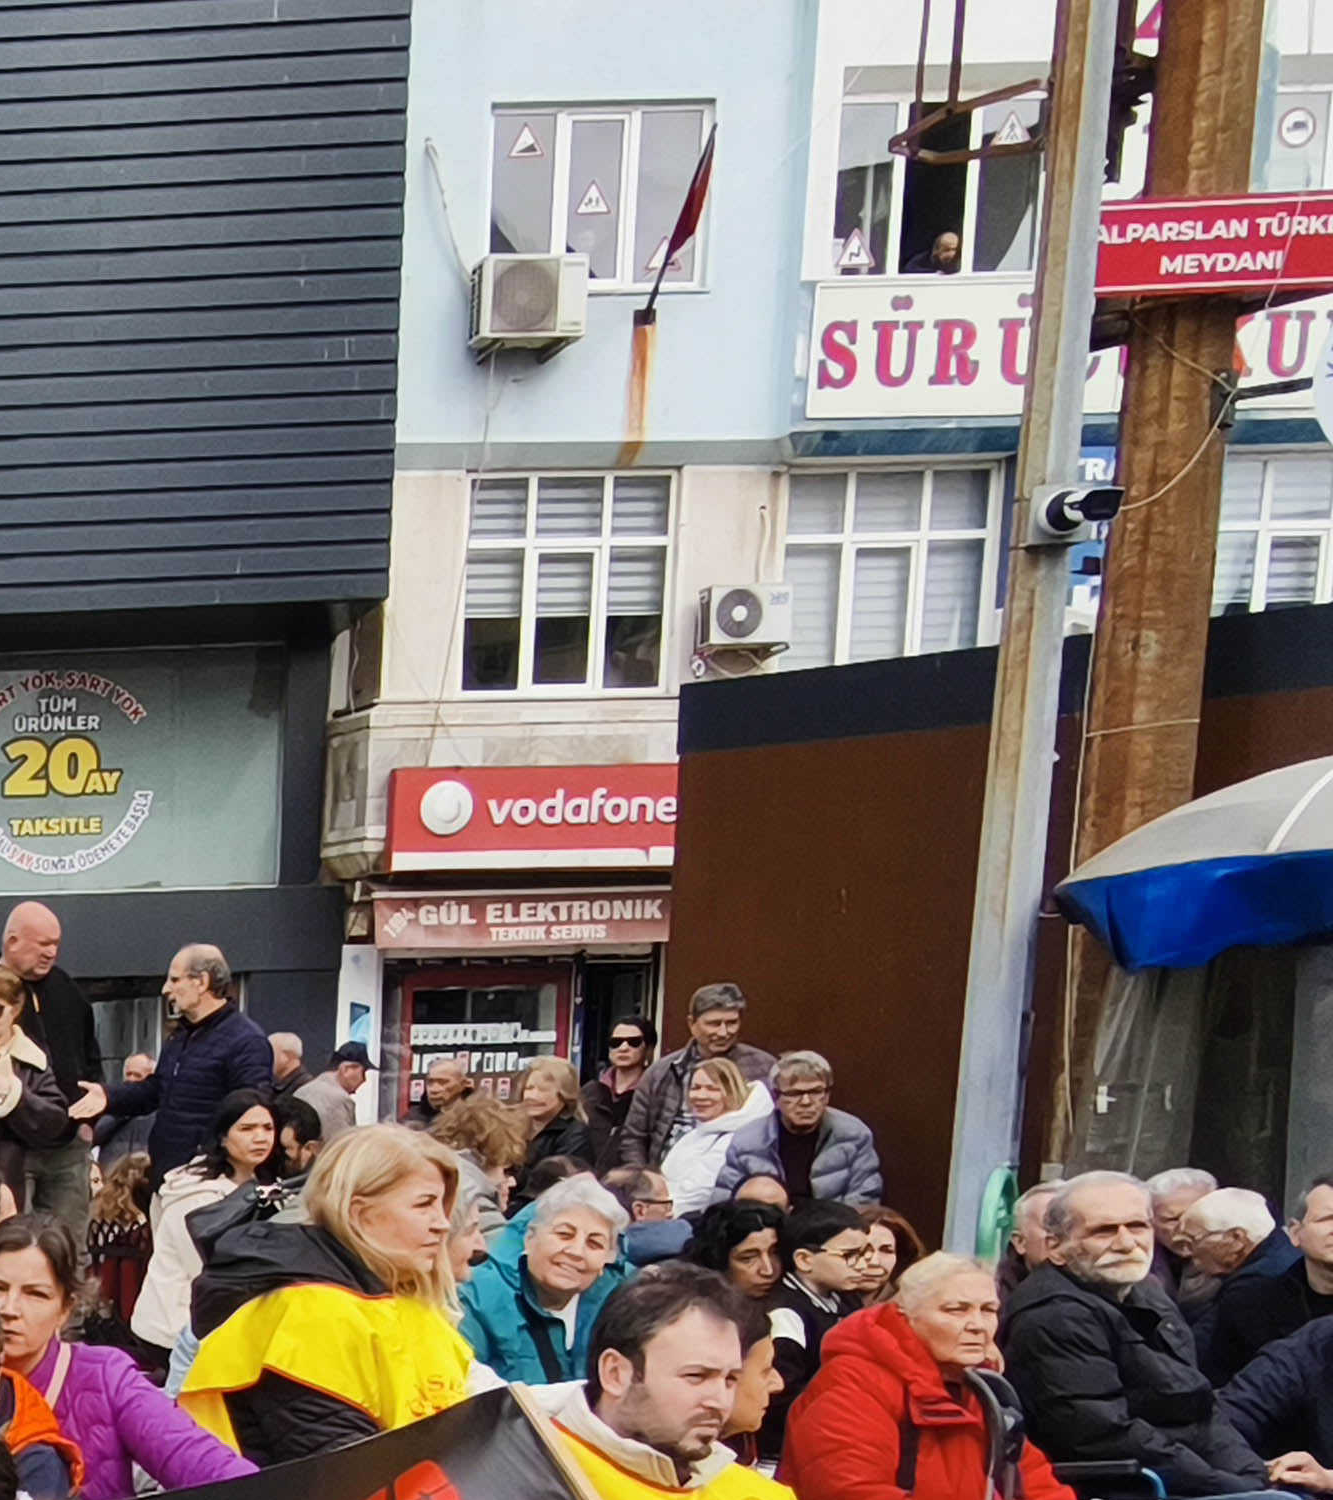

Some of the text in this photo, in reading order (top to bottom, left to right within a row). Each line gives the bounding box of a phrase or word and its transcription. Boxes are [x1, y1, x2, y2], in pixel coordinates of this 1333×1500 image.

[1098, 218, 1248, 245] ALPARSLAN
[1159, 251, 1284, 275] MEYDANI
[817, 294, 1033, 390] SÜRÜ
[37, 694, 78, 714] TÜM
[112, 686, 148, 725] YOK
[13, 713, 102, 733] ÜRÜNLER
[1, 734, 124, 798] 20 AY
[487, 787, 677, 826] vodafone
[418, 901, 477, 926] GÜL
